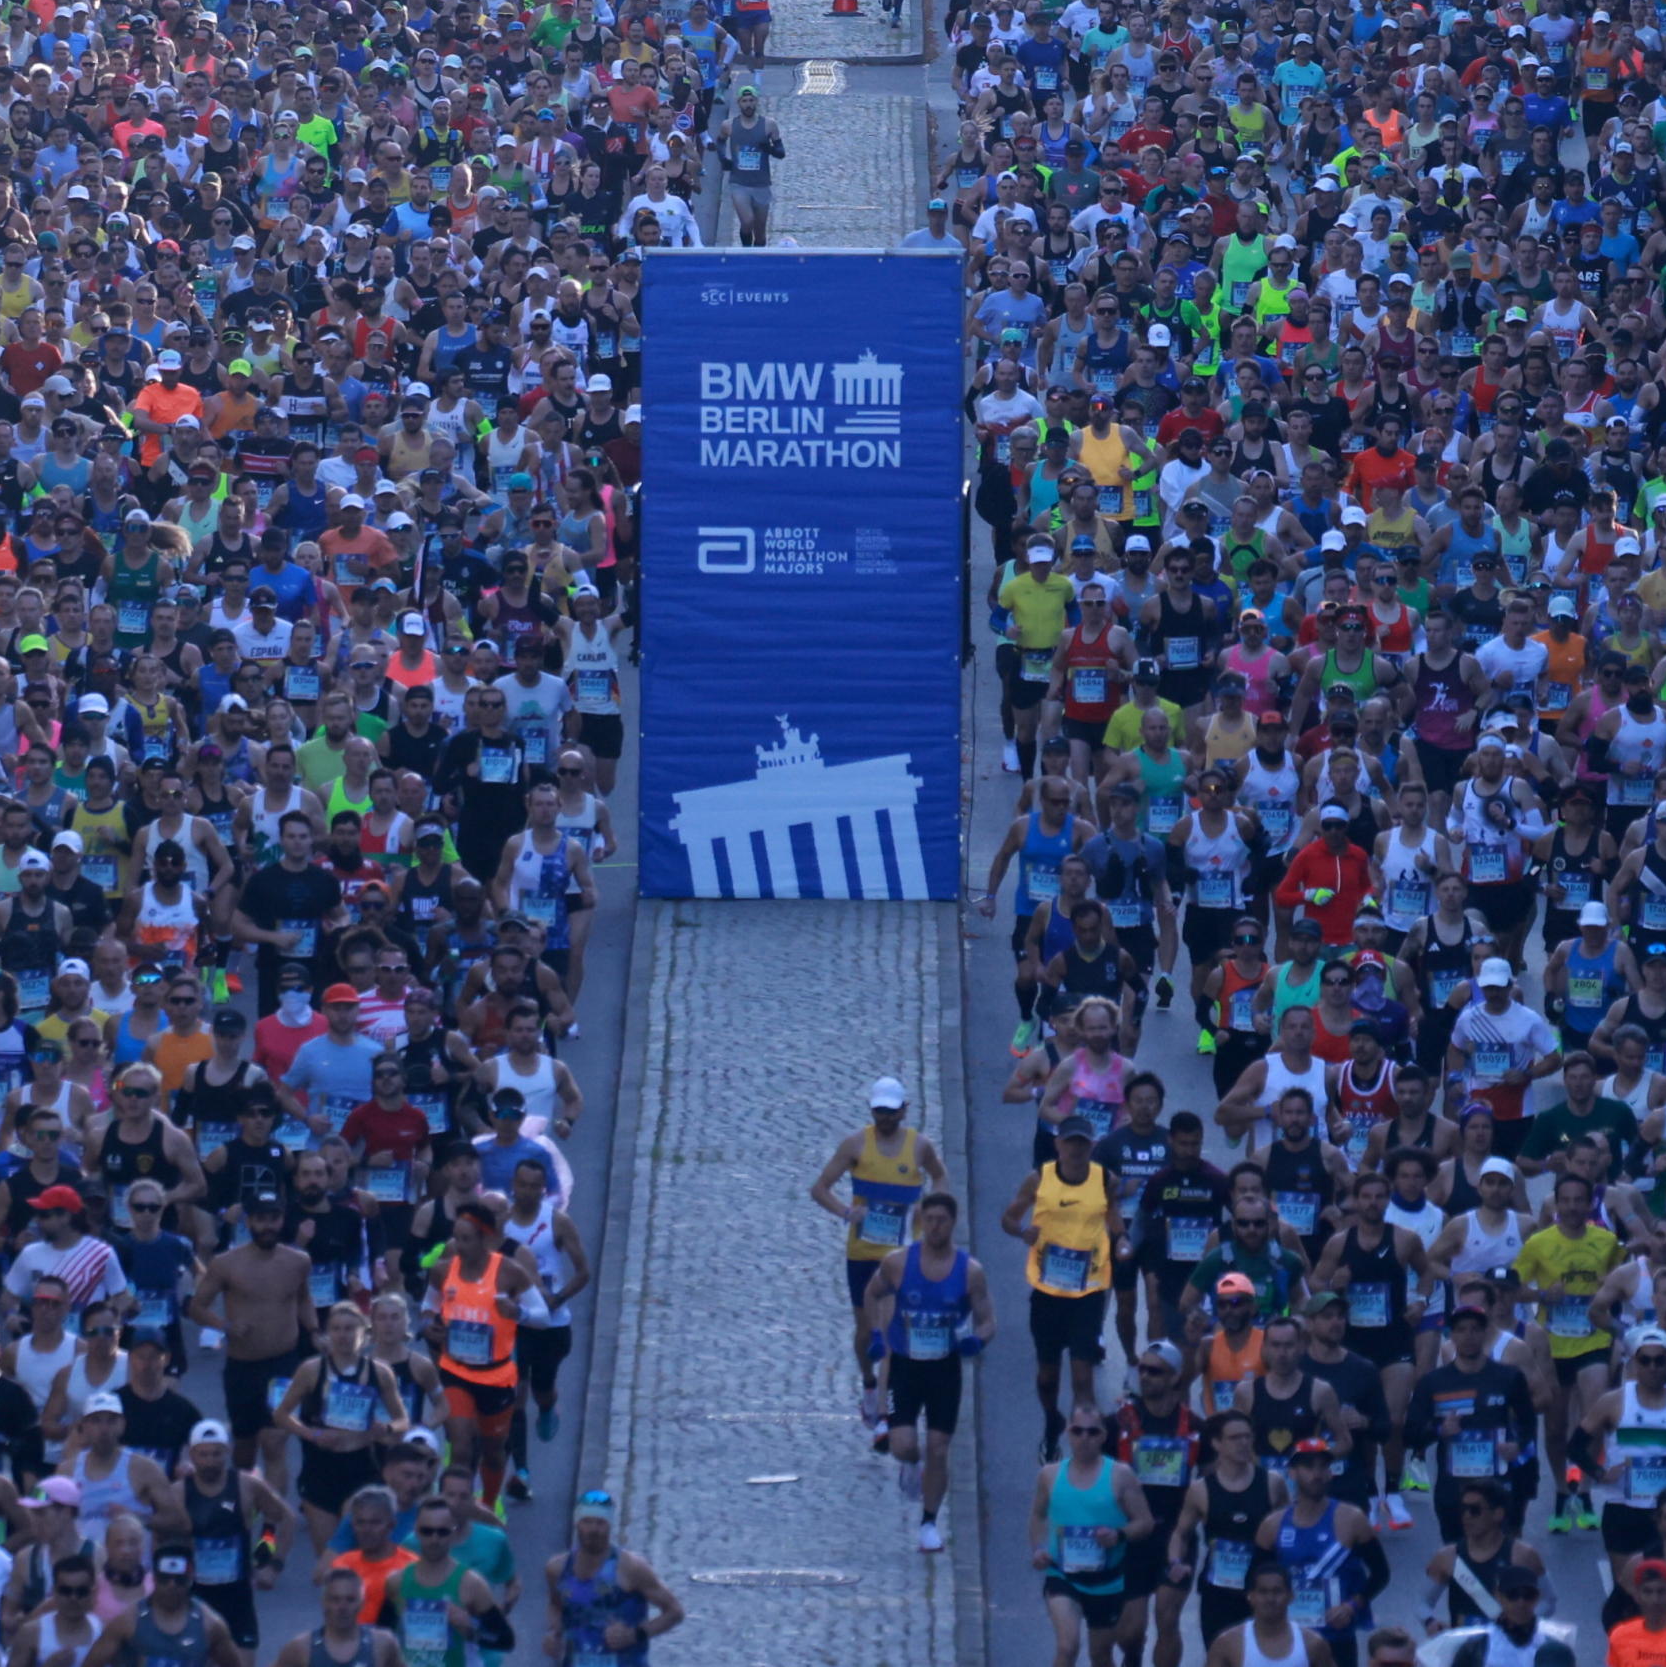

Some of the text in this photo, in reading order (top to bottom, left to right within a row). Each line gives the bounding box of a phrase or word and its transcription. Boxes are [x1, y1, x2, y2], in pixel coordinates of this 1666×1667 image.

[736, 292, 790, 304] EVENTS
[700, 362, 824, 401] BMW
[700, 406, 824, 435] BERLIN
[700, 439, 901, 468] MARATHON
[764, 527, 821, 539] ABBOTT
[764, 539, 815, 550] WORLD
[764, 551, 848, 562] MARATHON
[764, 563, 824, 575] MAJORS
